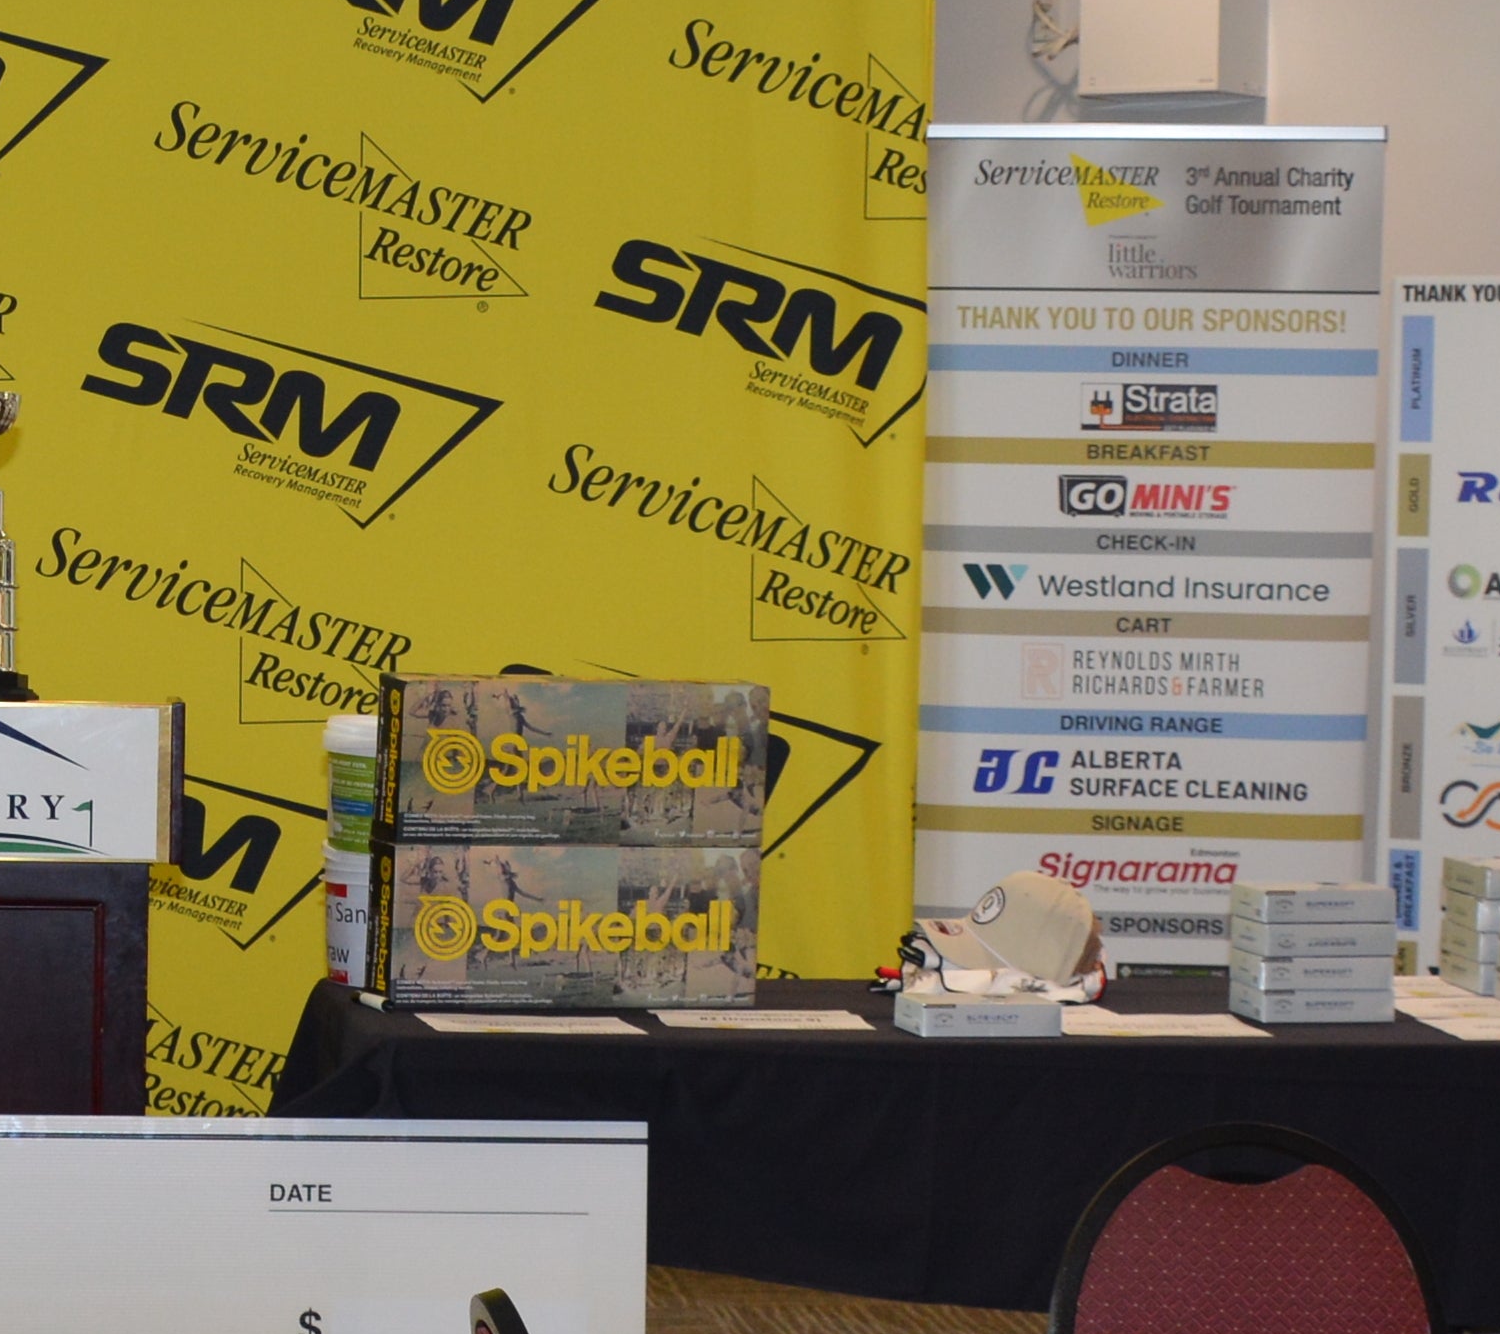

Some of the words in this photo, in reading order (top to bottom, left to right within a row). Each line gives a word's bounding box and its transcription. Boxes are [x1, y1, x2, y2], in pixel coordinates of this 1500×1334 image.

[154, 100, 532, 250] ServiceMASTER
[1186, 166, 1210, 186] 3rd
[1215, 168, 1280, 186] Annual
[1287, 168, 1353, 190] Charity
[1186, 196, 1223, 214] Golf
[1227, 197, 1341, 216] Tournament
[363, 228, 499, 293] Restore
[1403, 284, 1466, 302] THANK
[958, 306, 1039, 329] THANK
[1050, 307, 1096, 330] YOU
[1105, 308, 1134, 330] TO
[1144, 308, 1193, 331] OUR
[1203, 309, 1345, 333] SPONSORS!
[1112, 352, 1188, 368] DINNER
[1125, 386, 1216, 414] Strata
[1088, 445, 1210, 460] BREAKFAST
[1069, 483, 1126, 510] GO
[1097, 535, 1195, 551] CHECK-IN
[1038, 574, 1174, 599] Westland
[1185, 576, 1329, 601] Insurance
[1116, 617, 1171, 633] CART
[1060, 715, 1143, 732] DRIVING
[1150, 717, 1223, 733] RANGE
[489, 732, 741, 792] Spikeball
[1071, 751, 1182, 770] ALBERTA
[1070, 778, 1178, 797] SURFACE
[1185, 781, 1308, 801] CLEANING
[1092, 816, 1183, 832] SIGNAGE
[1038, 852, 1238, 888] Signarama
[481, 897, 733, 958] Spikeball
[1110, 917, 1223, 935] SPONSORS
[269, 1184, 332, 1202] DATE
